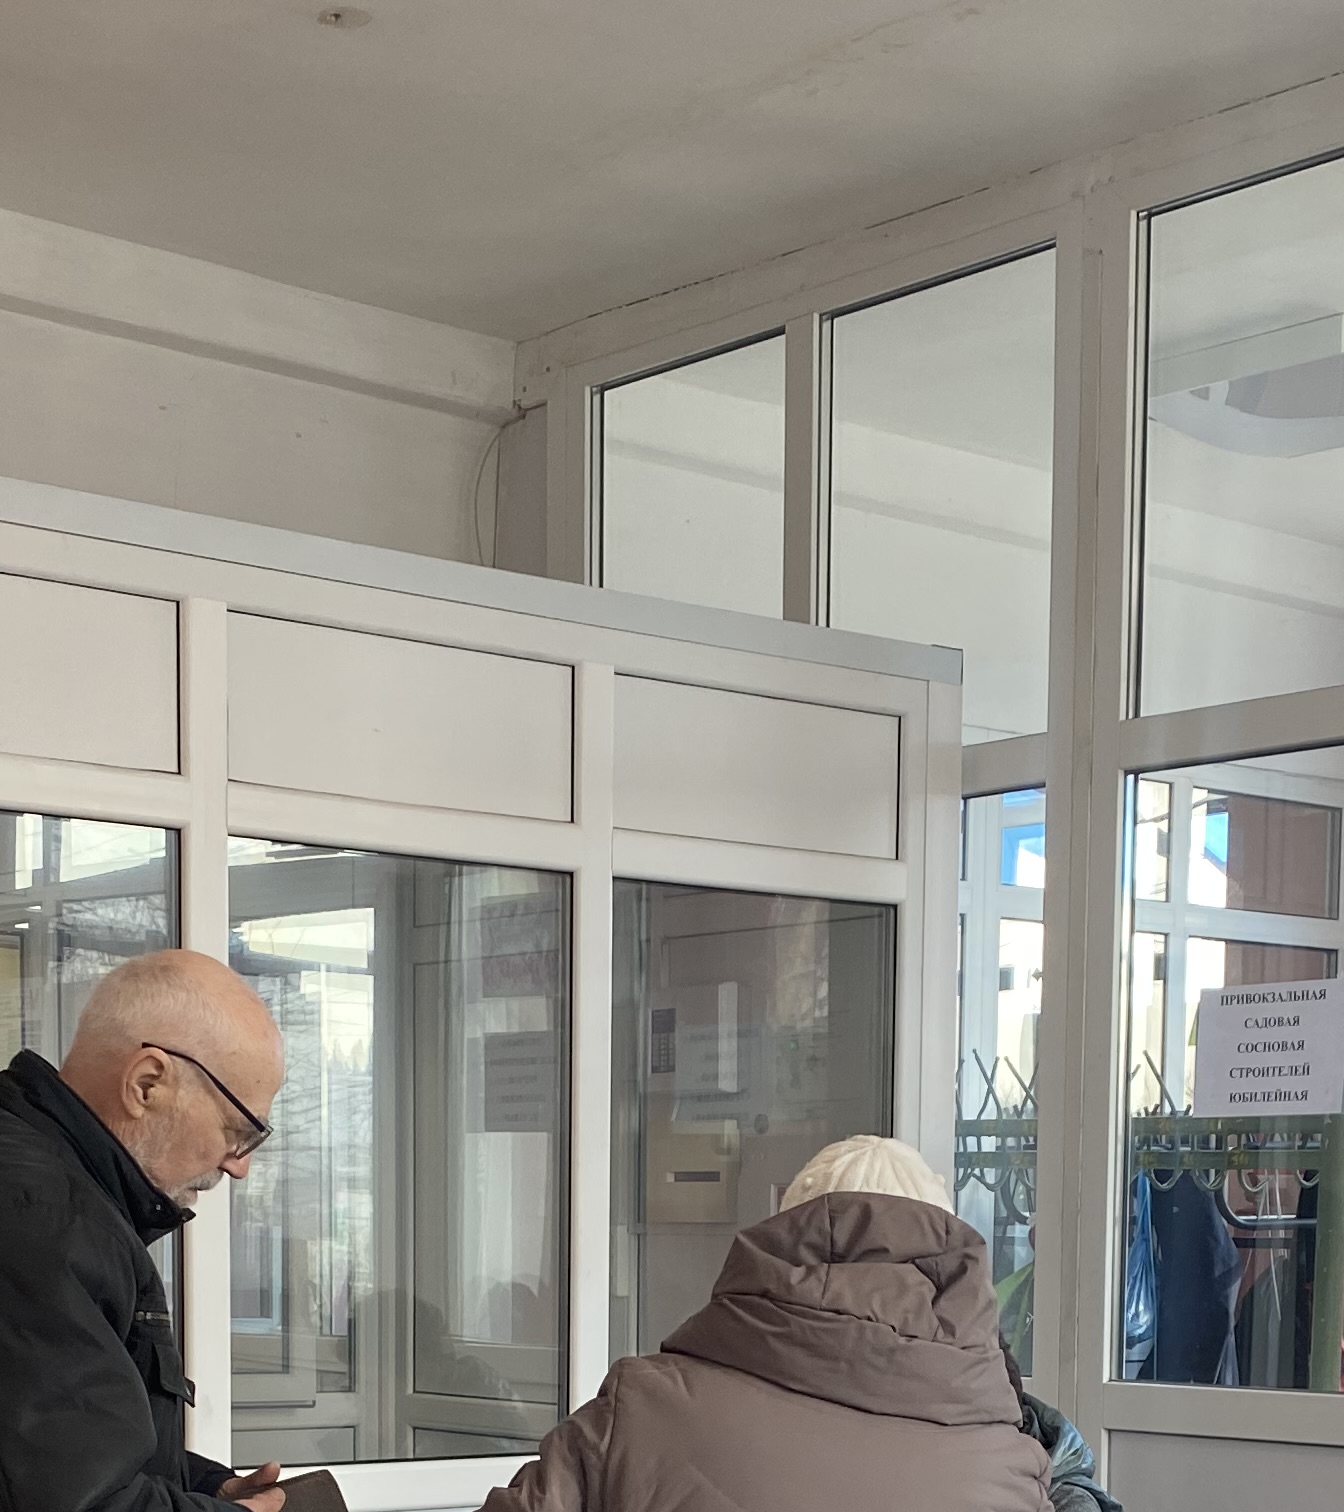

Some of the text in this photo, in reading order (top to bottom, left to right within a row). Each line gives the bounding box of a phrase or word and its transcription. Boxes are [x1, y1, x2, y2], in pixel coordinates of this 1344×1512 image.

[1220, 988, 1327, 1006] ПРИВОКЗАЛЬНАЯ
[1244, 1015, 1300, 1030] САДОВАЯ
[1237, 1039, 1305, 1054] СОСНОВАЯ
[1229, 1062, 1310, 1079] СТРОИТЕЛЕЙ
[1229, 1088, 1309, 1104] ЮБИЛЕЙНАЯ
